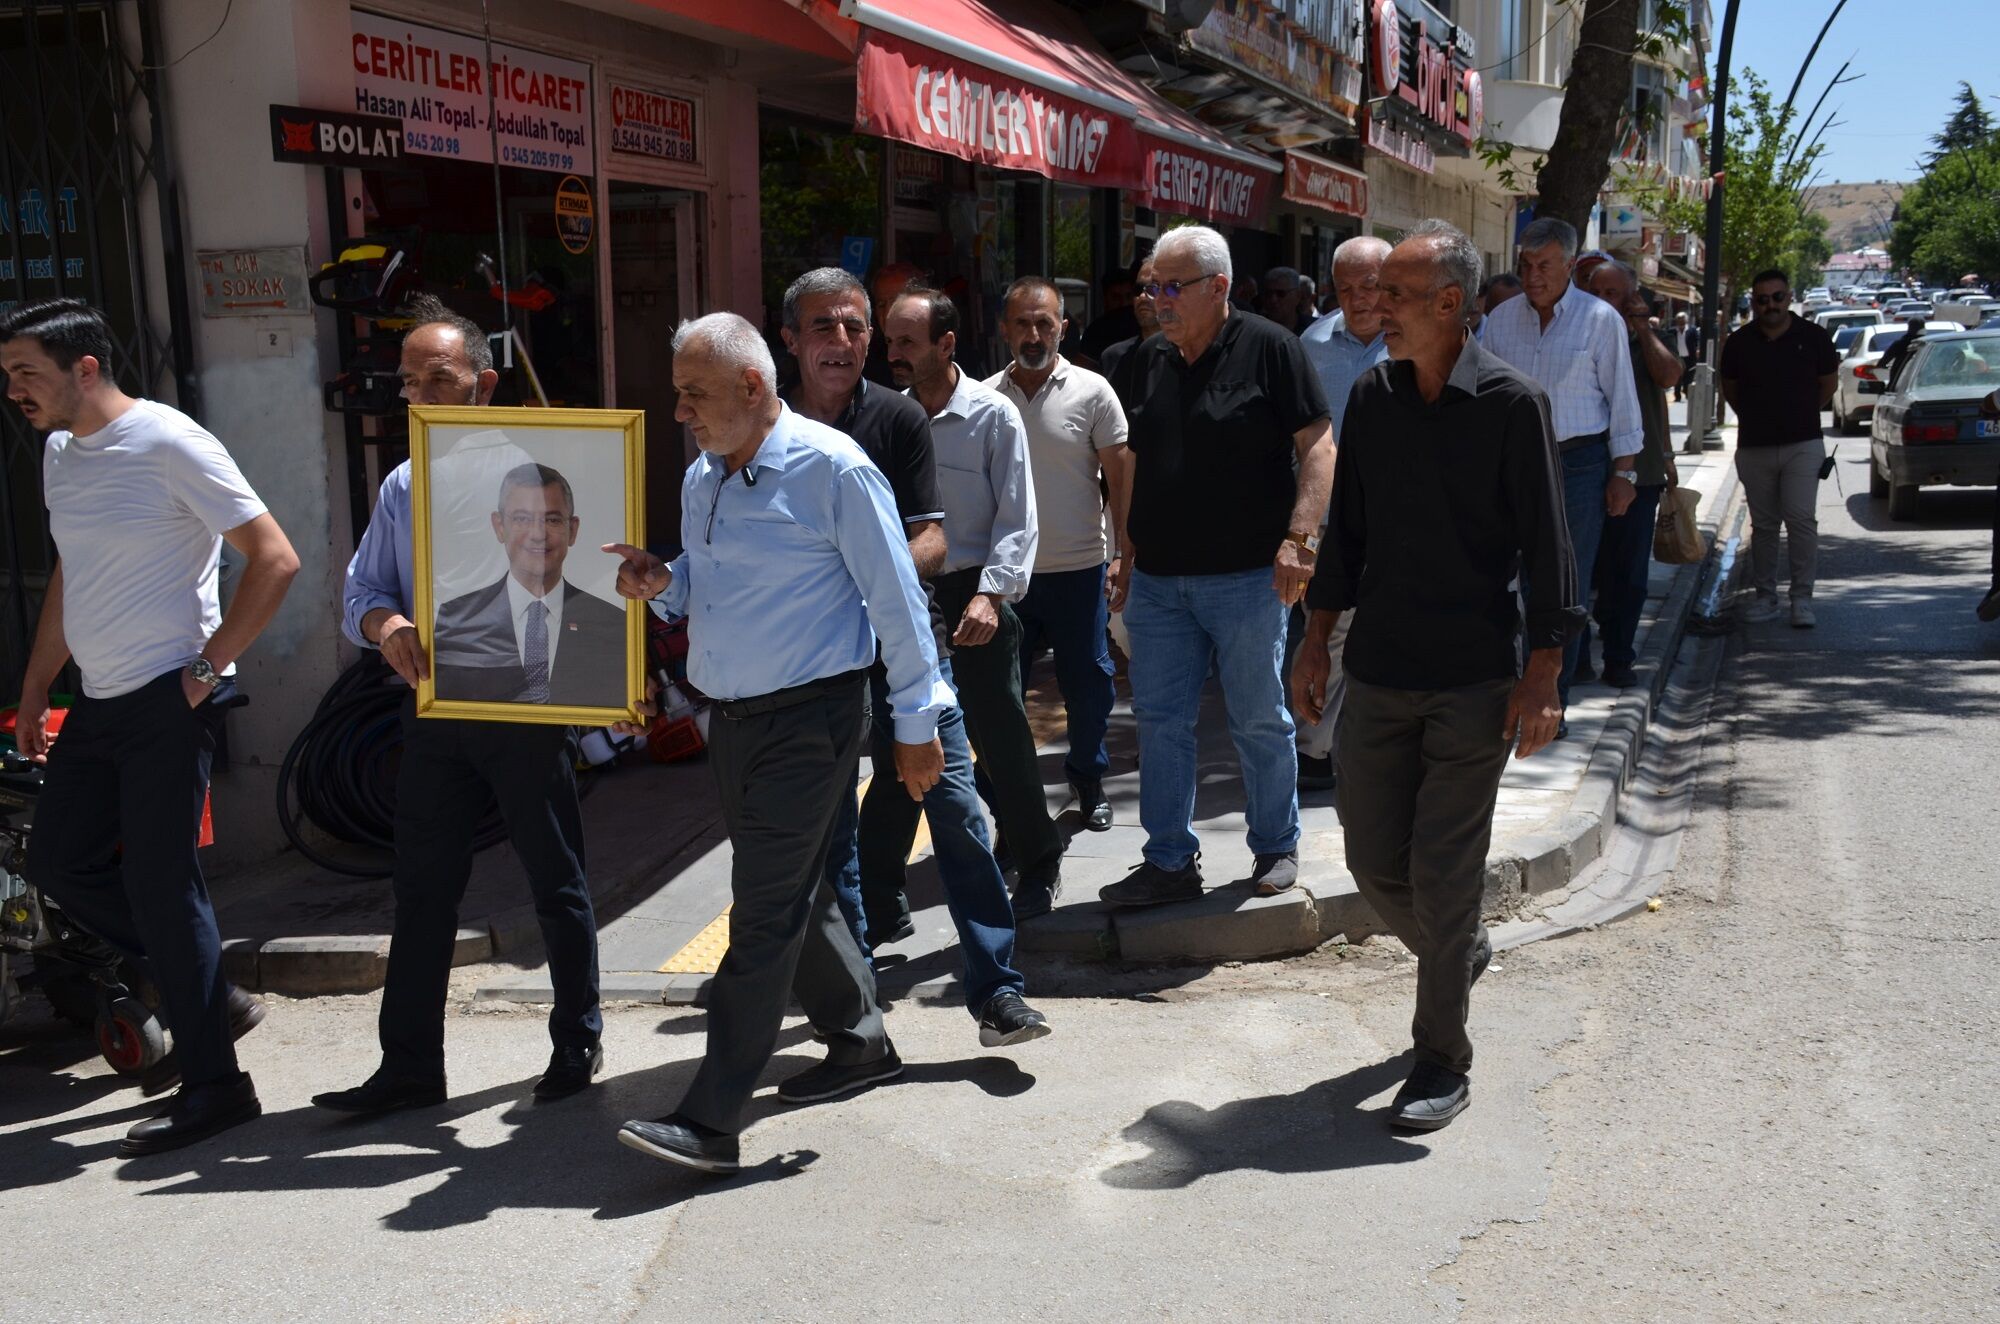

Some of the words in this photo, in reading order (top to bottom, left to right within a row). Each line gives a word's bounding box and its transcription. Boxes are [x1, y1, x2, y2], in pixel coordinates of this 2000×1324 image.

[352, 33, 482, 95] CERİTLER
[491, 55, 585, 114] TİCARET
[355, 87, 406, 118] Hasan
[410, 97, 432, 122] Ali
[435, 101, 476, 132] Topal
[550, 120, 585, 149] Topal
[612, 86, 691, 142] CERİTLER
[319, 122, 400, 158] BOLAT
[407, 132, 428, 151] 945
[431, 135, 444, 152] 20
[446, 137, 460, 155] 98
[612, 128, 641, 150] 0.544
[644, 134, 662, 155] 945
[665, 138, 677, 157] 20
[680, 142, 691, 160] 98
[1032, 99, 1108, 174] TCARET
[503, 145, 509, 161] 0
[511, 147, 529, 164] 545
[530, 149, 547, 167] 205
[549, 152, 560, 168] 97
[562, 154, 573, 170] 99
[1152, 149, 1208, 208] CERİTER
[222, 276, 288, 297] SOKAK
[269, 333, 277, 346] 2
